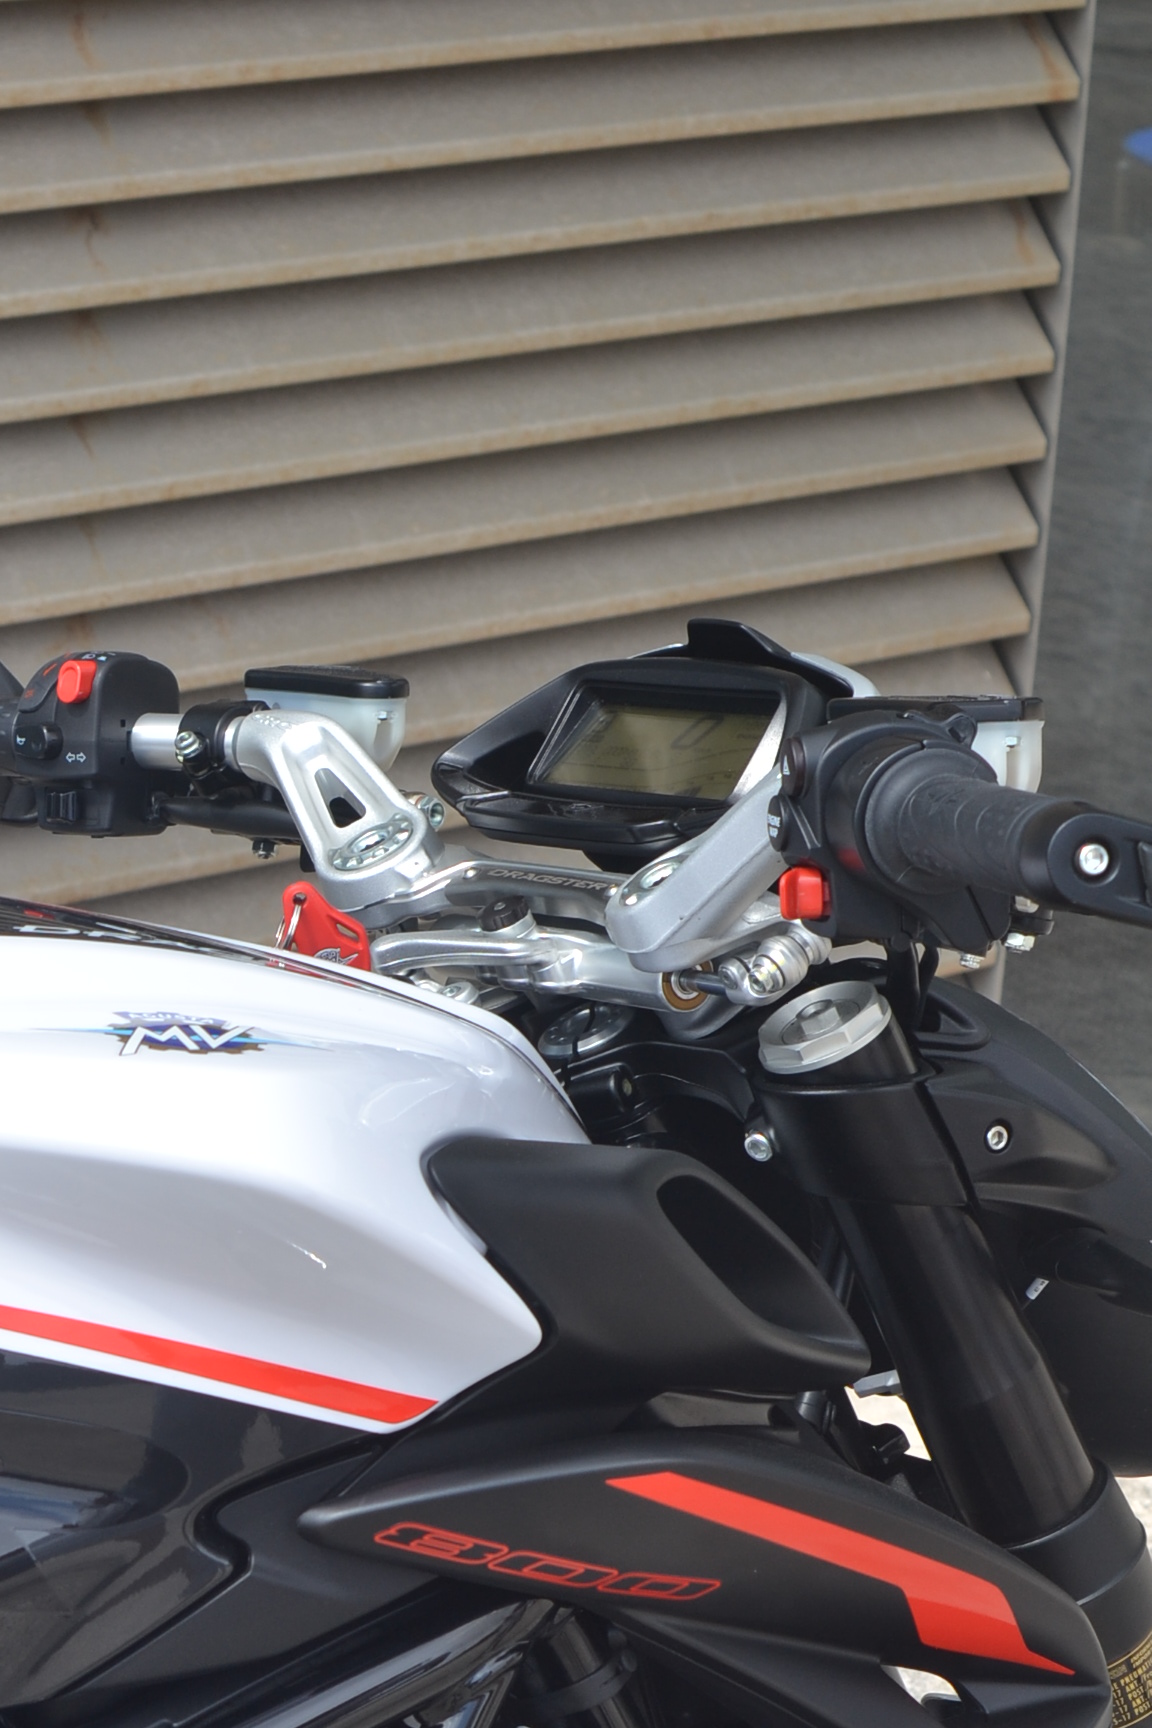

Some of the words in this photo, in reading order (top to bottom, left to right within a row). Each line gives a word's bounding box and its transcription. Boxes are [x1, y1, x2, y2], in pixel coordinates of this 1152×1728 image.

[488, 868, 608, 890] DRAGSTER
[119, 1024, 255, 1056] MV
[374, 1521, 722, 1600] 800
